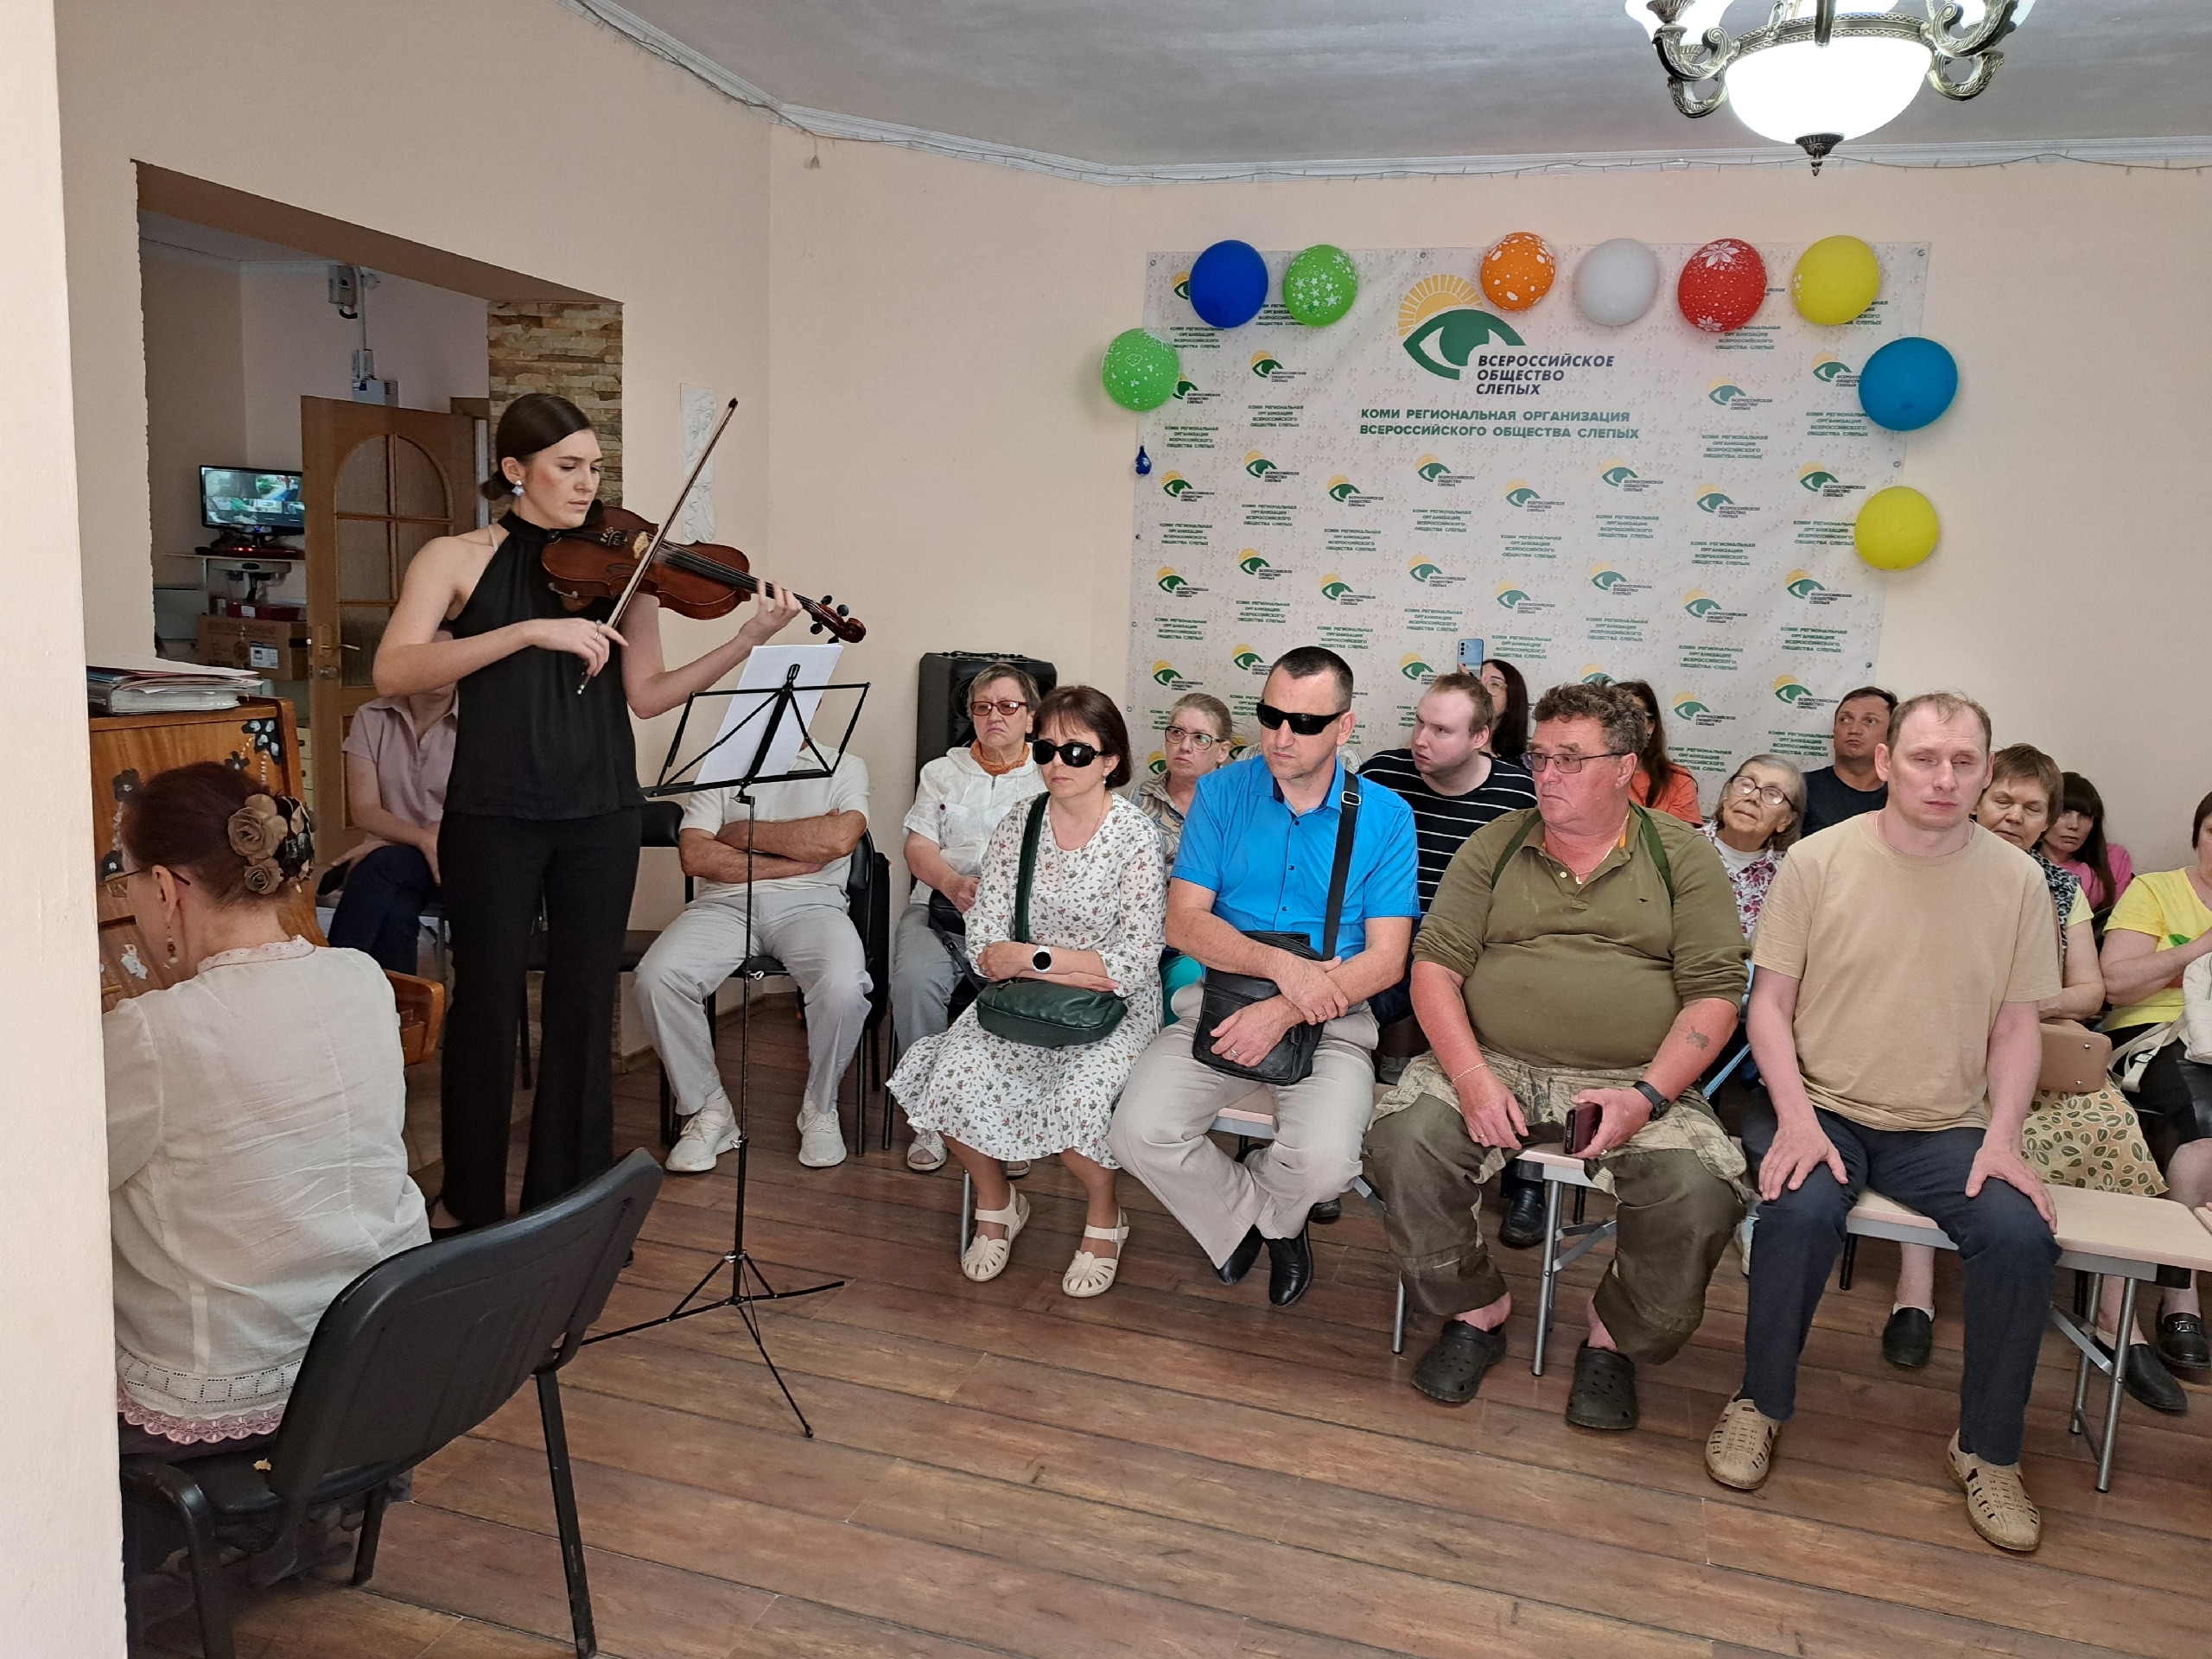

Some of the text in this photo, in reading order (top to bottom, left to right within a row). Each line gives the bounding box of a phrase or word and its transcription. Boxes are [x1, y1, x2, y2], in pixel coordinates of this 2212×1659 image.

[1478, 353, 1615, 367] ВСЕРОССИЙСКОЕ
[1477, 369, 1565, 382] ОБЩЕСТВО
[1476, 384, 1541, 395] СЛЕПЫХ
[1361, 409, 1630, 423] КОМИ РЕГИОНАЛЬНАЯ ОРГАНИЗАЦИЯ
[1360, 423, 1640, 439] ВСЕРОССИЙСКОГО ОБЩЕСТВА СЛЕПЫХ
